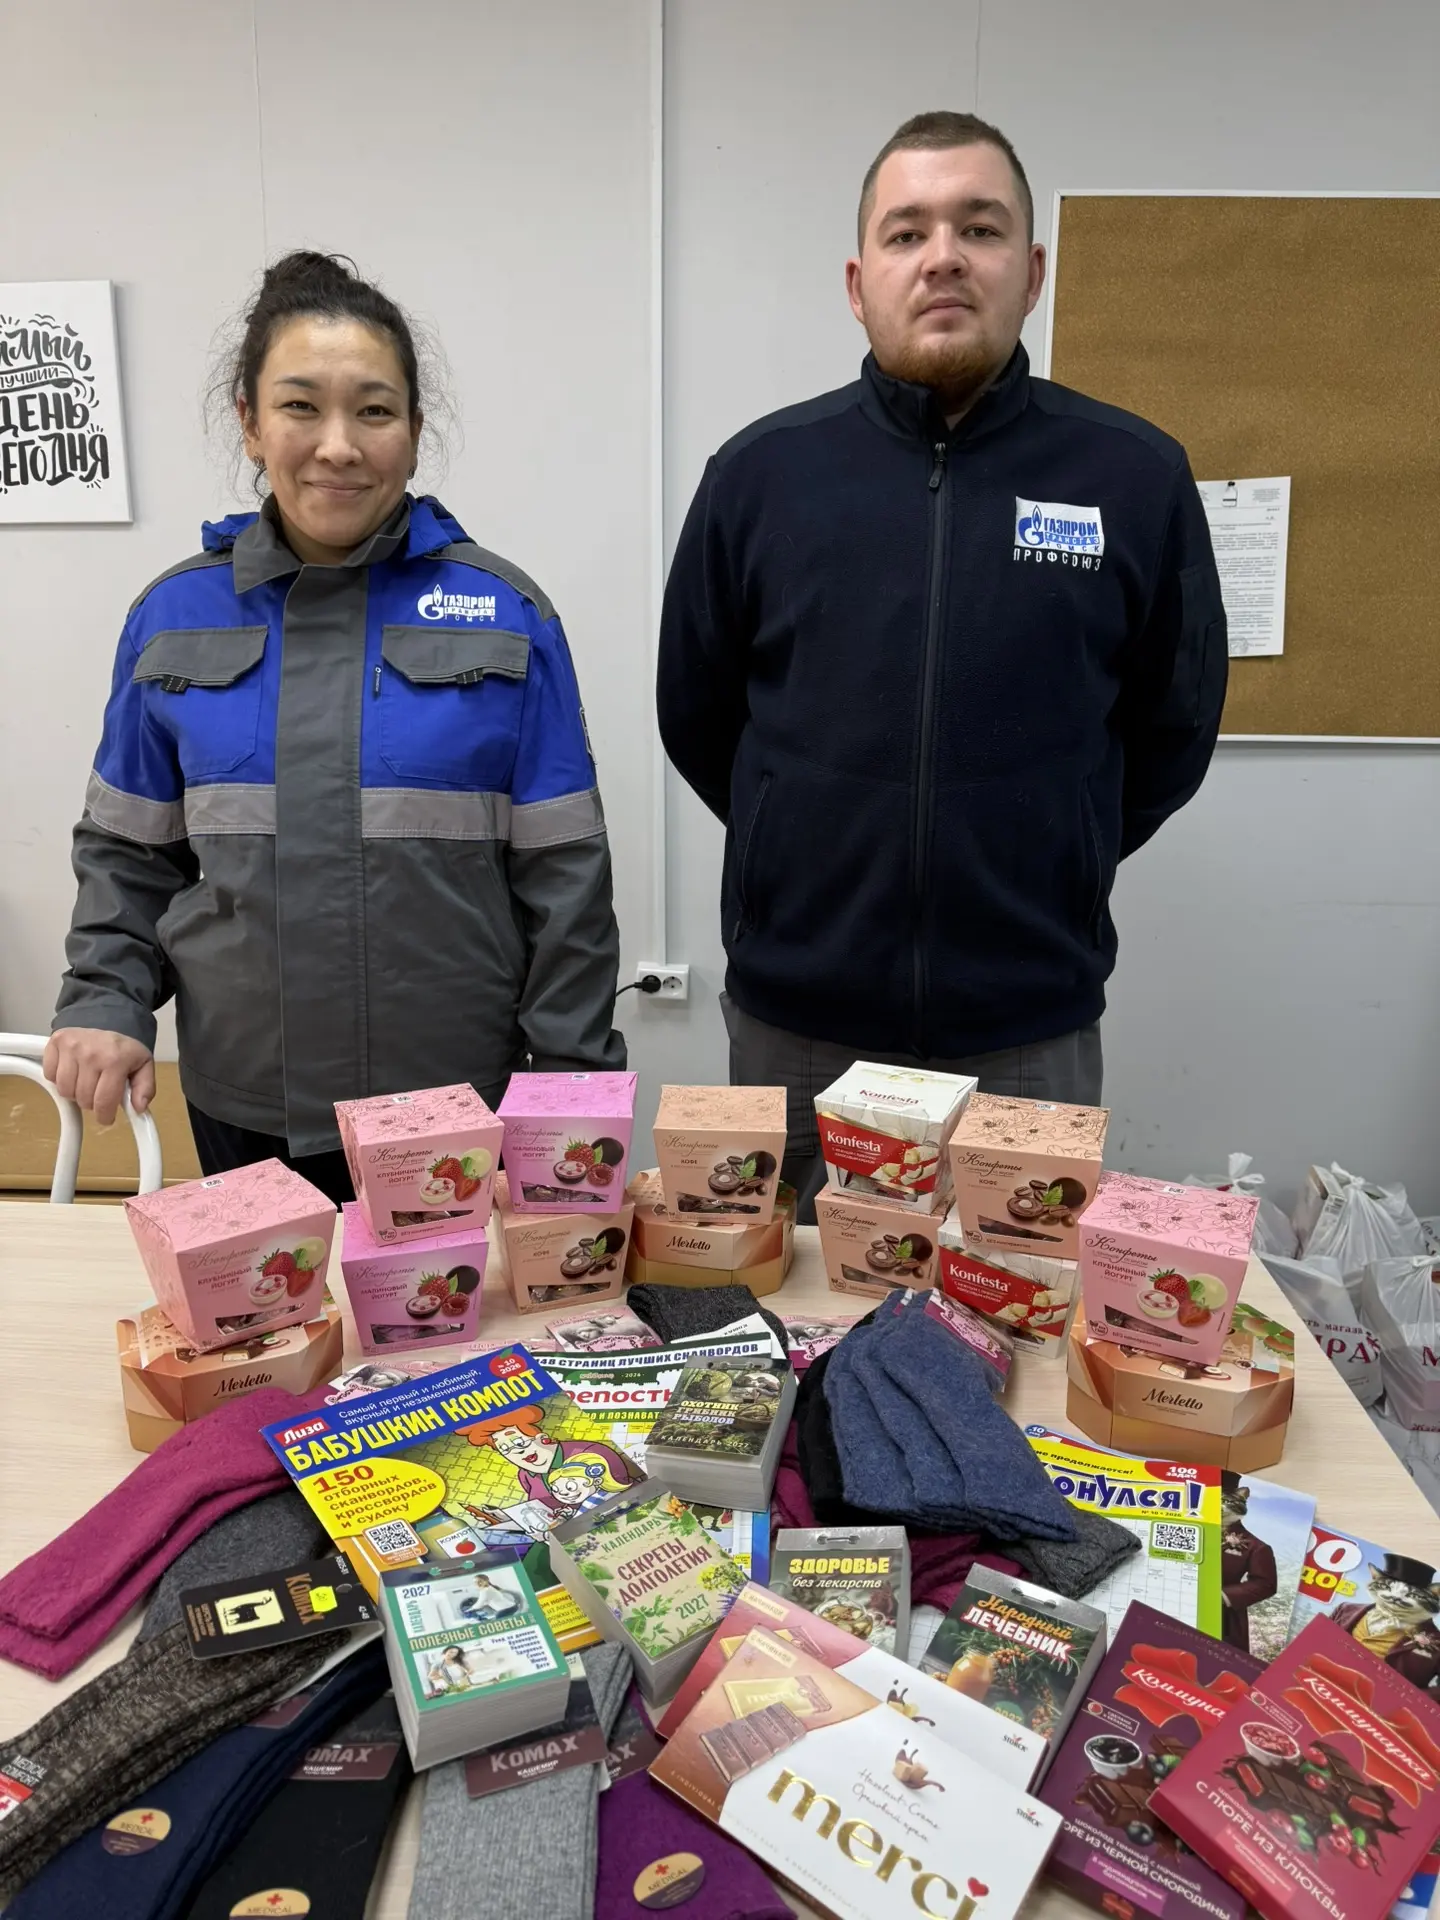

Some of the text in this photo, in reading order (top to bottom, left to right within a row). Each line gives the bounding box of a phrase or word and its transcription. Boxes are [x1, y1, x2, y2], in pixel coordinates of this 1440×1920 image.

[0, 432, 110, 487] ЕГОДНЯ
[1044, 517, 1099, 537] ГАЗПРОМ
[1045, 532, 1100, 545] ТРАНСГАЗ
[1045, 541, 1100, 553] ТОМСК
[1013, 548, 1101, 571] ПРОФСОЮЗ
[443, 594, 496, 609] ГАЗПРОМ
[444, 614, 496, 622] ТОМСК
[859, 1089, 920, 1106] Konfesta
[827, 1130, 881, 1153] Konfesta
[369, 1147, 434, 1171] Конфеты
[957, 1151, 1024, 1178] Конфеты
[376, 1166, 427, 1179] КЛУБНИЧНЫЙ
[388, 1175, 415, 1185] ЙОГУРТ
[979, 1179, 998, 1187] КОФЕ
[822, 1207, 878, 1231] Конфеты
[666, 1235, 712, 1251] Merletto
[1085, 1234, 1158, 1263] Конфеты
[197, 1266, 252, 1286] КЛУБНИЧНЫЙ
[950, 1263, 1009, 1293] Konfesta
[1092, 1260, 1147, 1278] КЛУБНИЧНЫЙ
[1104, 1269, 1133, 1282] ЙОГУРТ
[211, 1277, 240, 1290] ЙОГУРТ
[360, 1283, 408, 1296] МАЛИНОВЫЙ
[371, 1292, 397, 1300] ЙОГУРТ
[504, 1358, 516, 1366] 10
[558, 1358, 615, 1368] СТРАНИЦ
[617, 1353, 672, 1367] ЛУЧШИХ
[213, 1372, 273, 1397] Merletto
[338, 1402, 378, 1419] Самый
[379, 1389, 420, 1408] первый
[421, 1387, 430, 1396] и
[431, 1368, 482, 1392] любимый,
[345, 1407, 393, 1427] вкусный
[393, 1404, 401, 1412] и
[403, 1377, 478, 1408] незаменимый!
[1142, 1388, 1203, 1411] Merletto
[284, 1368, 545, 1472] БАБУШКИН КОМПОТ
[607, 1411, 660, 1420] ПОЗНАВАТ
[672, 1413, 736, 1425] РЫБОЛОВ
[284, 1421, 326, 1444] Лиза
[660, 1434, 722, 1446] КАЛЕНДАРЬ
[1050, 1452, 1135, 1476] продолжается!
[1168, 1465, 1199, 1475] 100
[312, 1465, 374, 1494] 150
[323, 1474, 400, 1503] отборных
[329, 1477, 427, 1511] сканвордов,
[335, 1482, 437, 1521] кроссвордов
[340, 1502, 411, 1529] и судоку
[601, 1518, 662, 1554] КАЛЕНДАРЬ
[616, 1537, 688, 1581] СЕКРЕТЫ
[788, 1556, 891, 1574] ЗДОРОВЬЕ
[617, 1545, 713, 1607] ДОЛГОЛЕТИЯ
[792, 1576, 882, 1590] без лекарств
[402, 1585, 431, 1599] 2027
[674, 1593, 710, 1620] 2027
[977, 1594, 1074, 1640] Народный
[409, 1627, 477, 1652] ПОЛЕЗНЫЕ
[477, 1616, 529, 1638] СОВЕТЫ
[963, 1606, 1073, 1661] ЛЕЧЕБНИК
[1131, 1667, 1228, 1720] Коммуна
[1303, 1677, 1430, 1779] Коммунарка
[490, 1735, 579, 1773] KOMAX
[1003, 1733, 1026, 1753] STORCK
[1, 1763, 41, 1788] COMFORT
[11, 1753, 48, 1780] MEDICAL
[517, 1759, 559, 1777] КАШЕМИР
[852, 1782, 930, 1843] Ореховый крем
[767, 1766, 981, 1920] merci
[1074, 1817, 1115, 1845] шоколад
[1195, 1780, 1346, 1920] С ПЮРЕ ИЗ КЛЮКВЫ
[647, 1867, 688, 1892] MEDICAL
[1085, 1836, 1101, 1849] ИЗ
[1102, 1842, 1149, 1876] ЧЕРНОЙ
[1149, 1869, 1231, 1920] СМОРОДИНЫ
[247, 1905, 292, 1915] MEDICAL
